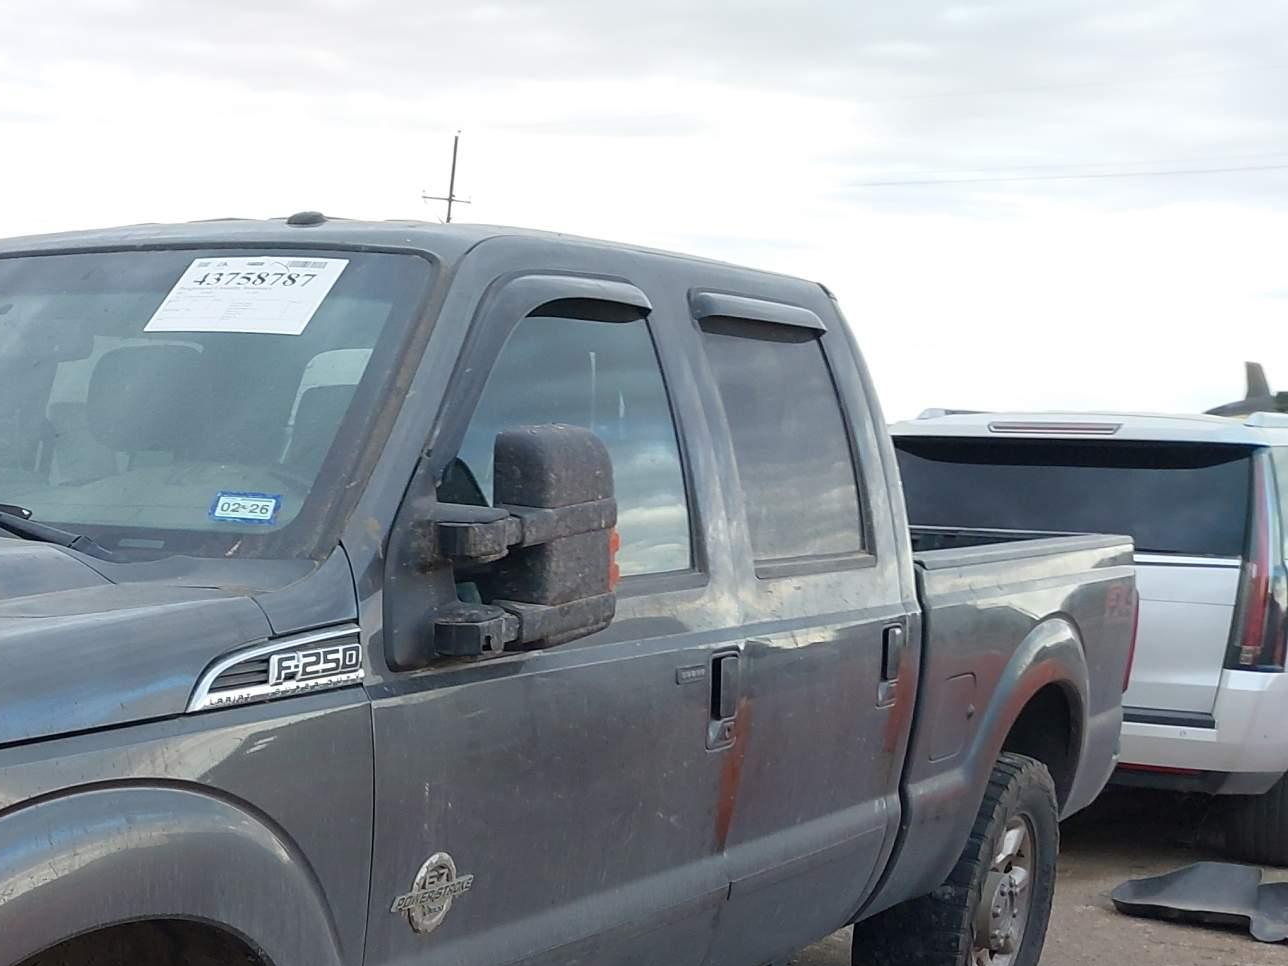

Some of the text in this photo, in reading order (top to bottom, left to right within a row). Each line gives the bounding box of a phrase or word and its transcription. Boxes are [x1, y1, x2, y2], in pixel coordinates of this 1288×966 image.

[193, 272, 318, 287] 43758787
[220, 502, 270, 515] 02-26
[274, 645, 361, 683] F-250
